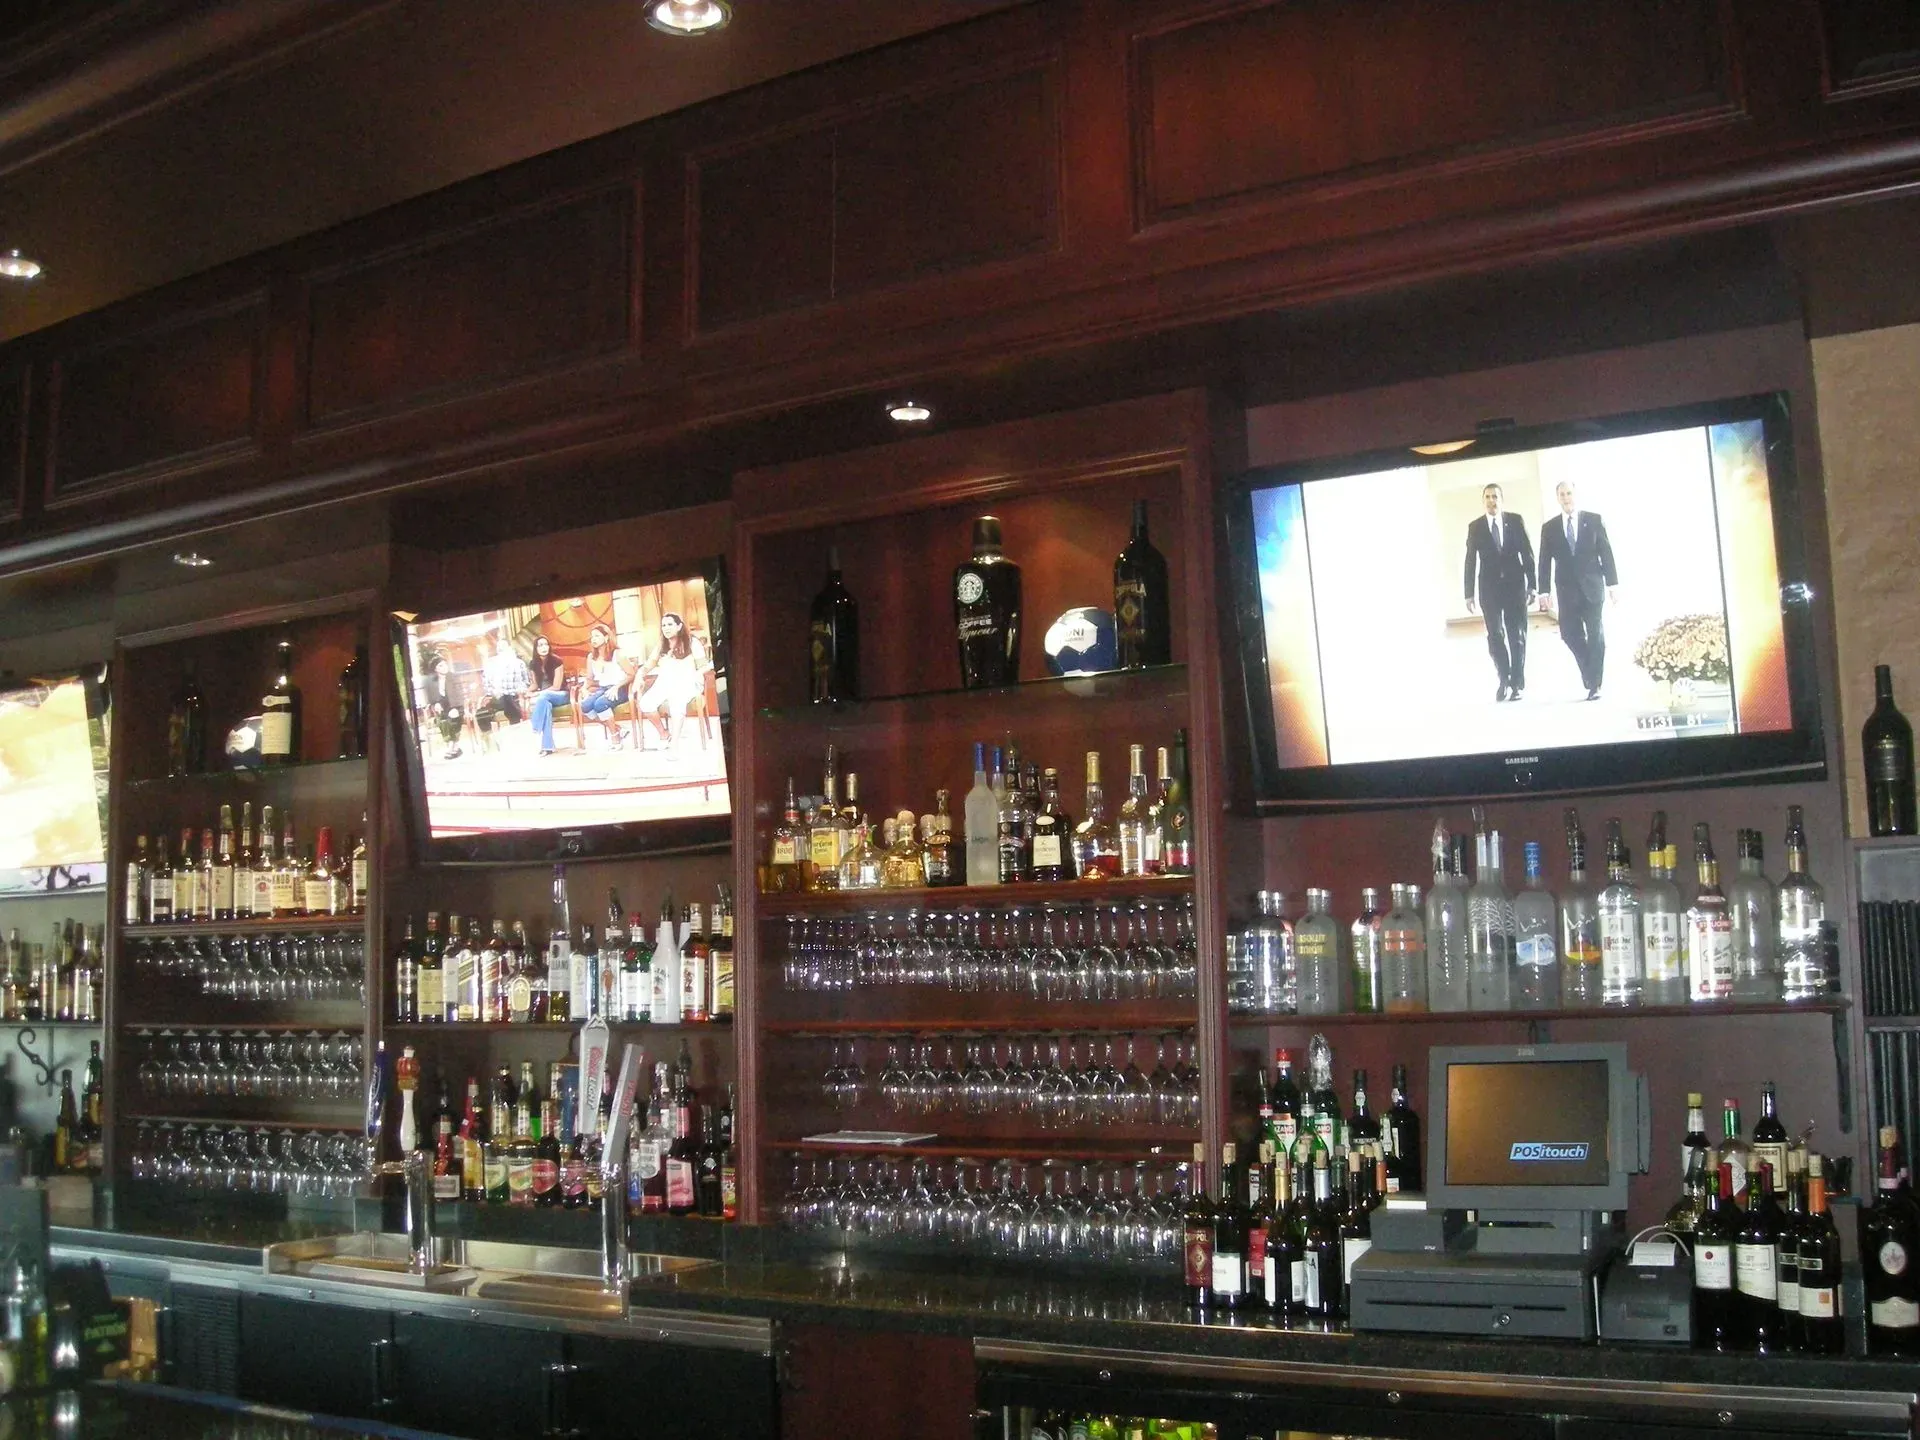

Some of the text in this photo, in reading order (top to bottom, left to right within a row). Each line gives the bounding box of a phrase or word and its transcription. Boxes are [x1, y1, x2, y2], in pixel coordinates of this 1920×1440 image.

[959, 619, 992, 629] COFFEE
[776, 847, 793, 855] 1800
[1513, 1146, 1585, 1158] POSitouch
